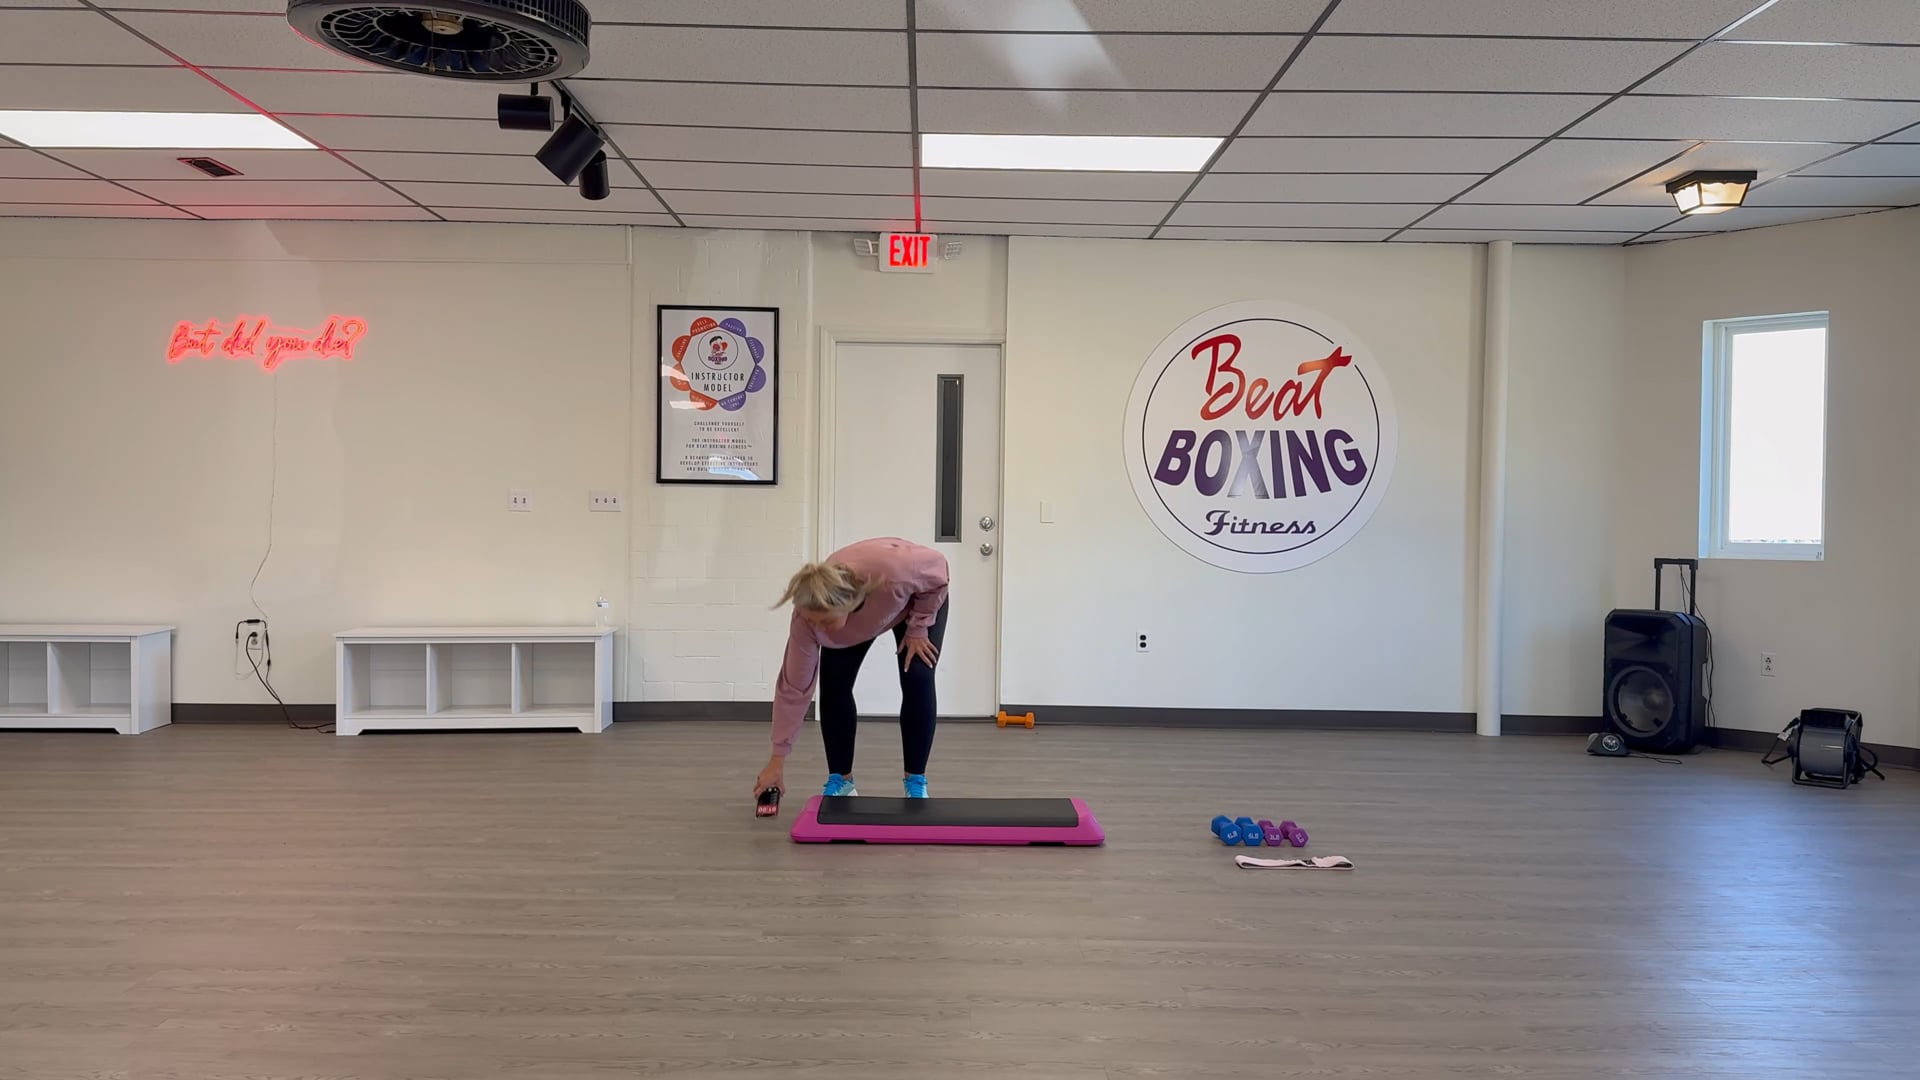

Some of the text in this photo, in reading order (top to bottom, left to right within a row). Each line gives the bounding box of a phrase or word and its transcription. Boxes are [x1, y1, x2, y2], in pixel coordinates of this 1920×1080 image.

[889, 234, 931, 268] EXIT
[167, 318, 364, 369] But did you die?
[691, 372, 745, 382] INSTRUCTOR
[703, 383, 732, 393] MODEL
[1190, 334, 1353, 422] Beat
[1154, 429, 1368, 500] BOXING
[1204, 509, 1317, 536] Fitness
